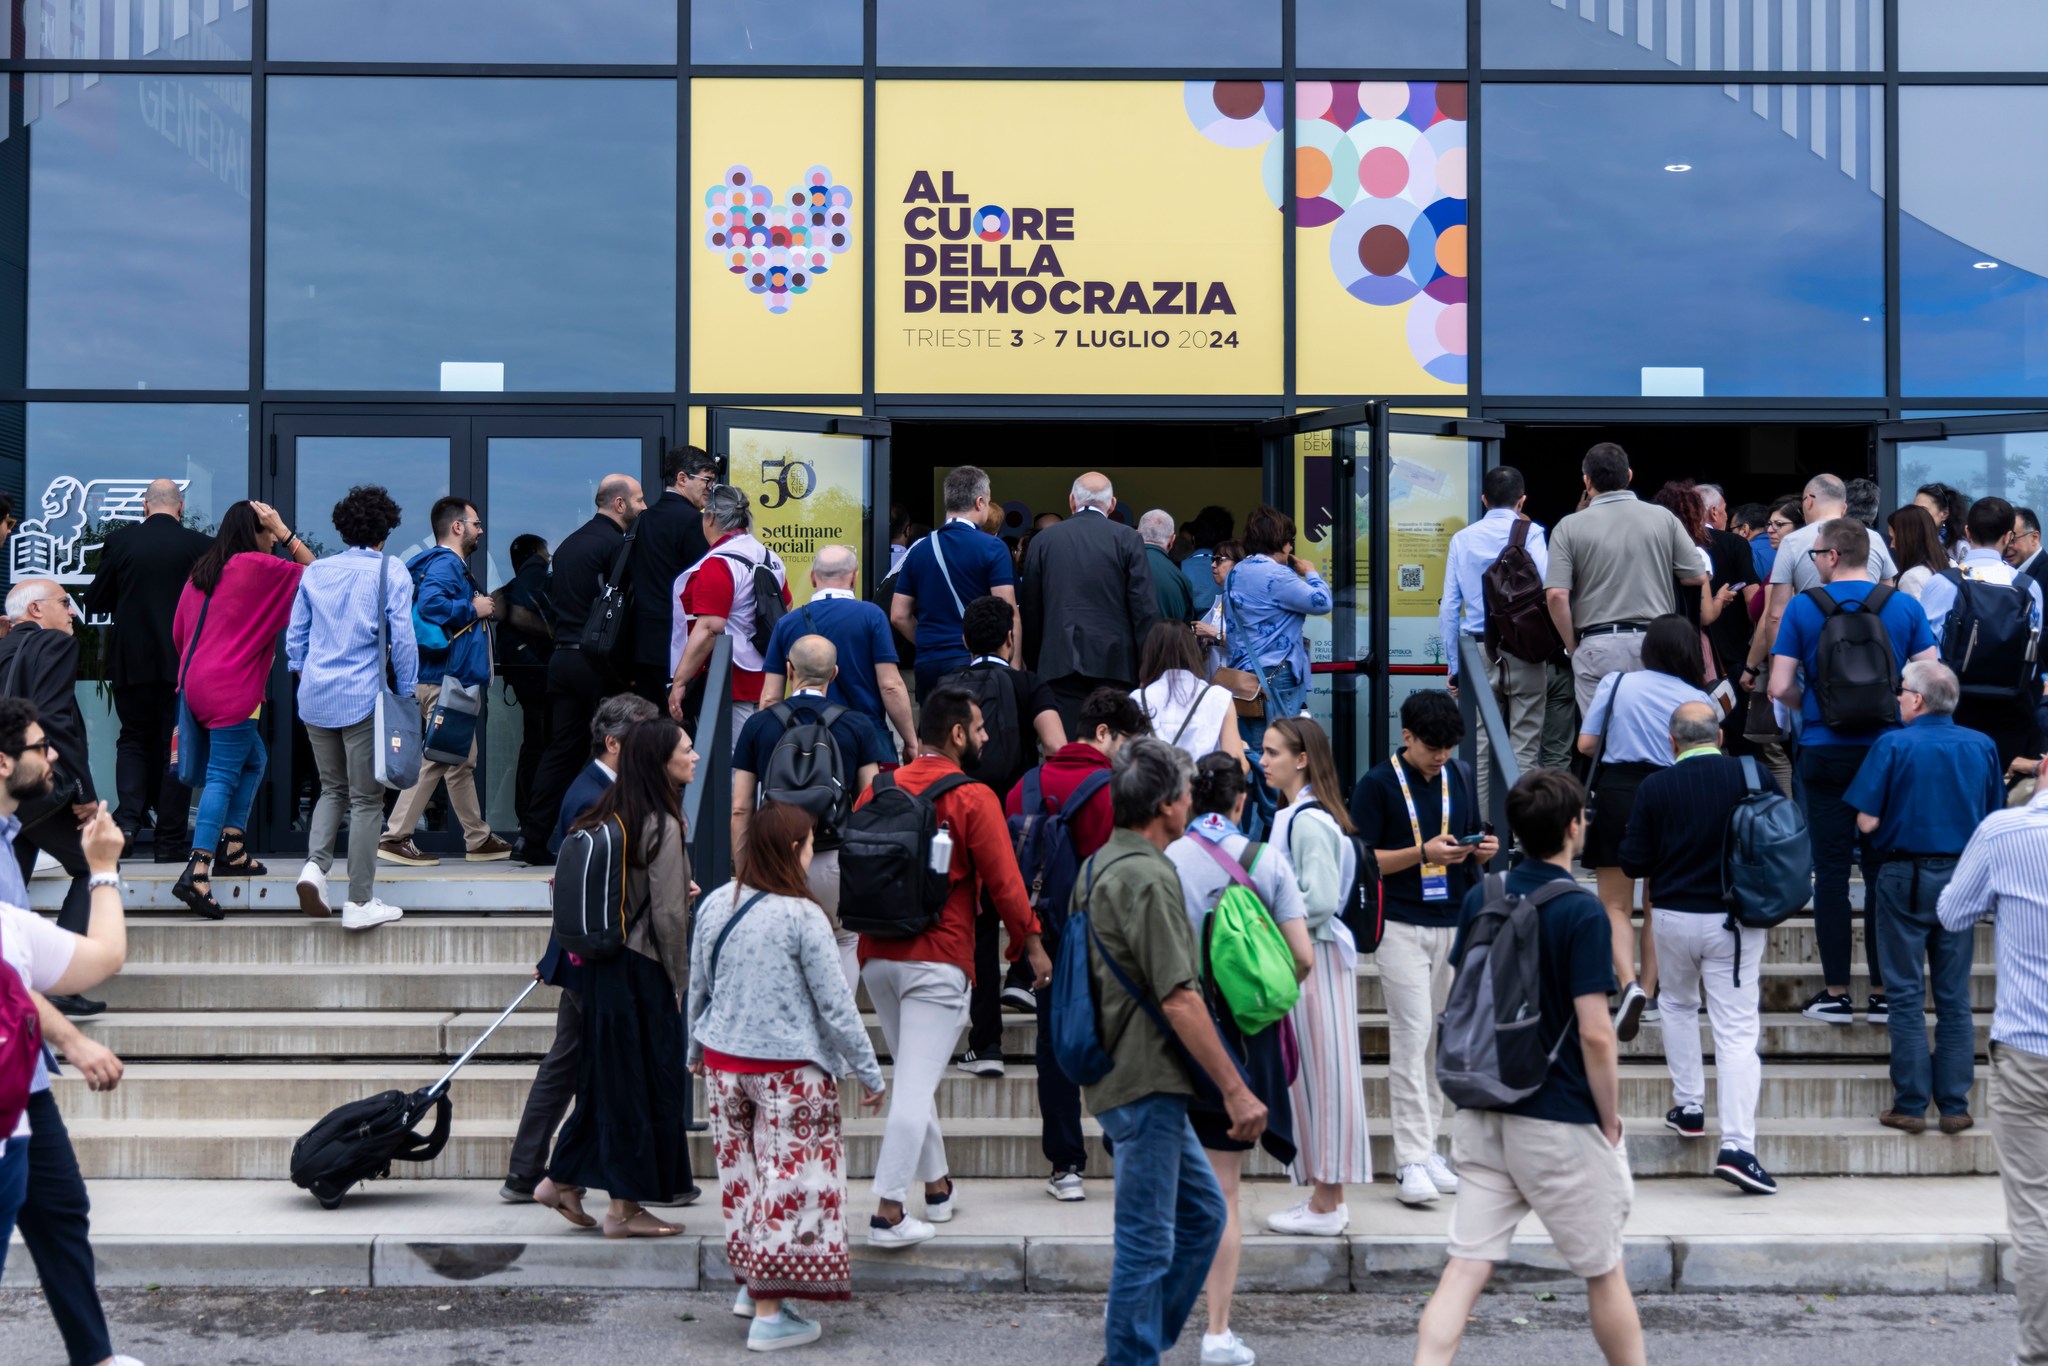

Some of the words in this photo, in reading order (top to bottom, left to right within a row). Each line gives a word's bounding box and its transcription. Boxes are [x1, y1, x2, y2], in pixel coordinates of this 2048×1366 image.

[903, 170, 969, 203] AL
[903, 205, 1075, 242] CUORE
[904, 244, 1064, 277] DELLA
[904, 280, 1236, 315] DEMOCRAZIA
[903, 329, 1001, 348] TRIESTE
[1010, 329, 1024, 348] 3
[1054, 329, 1068, 348] 7
[1077, 329, 1170, 348] LUGLIO
[1178, 329, 1239, 348] 2024
[1304, 431, 1332, 441] DELL
